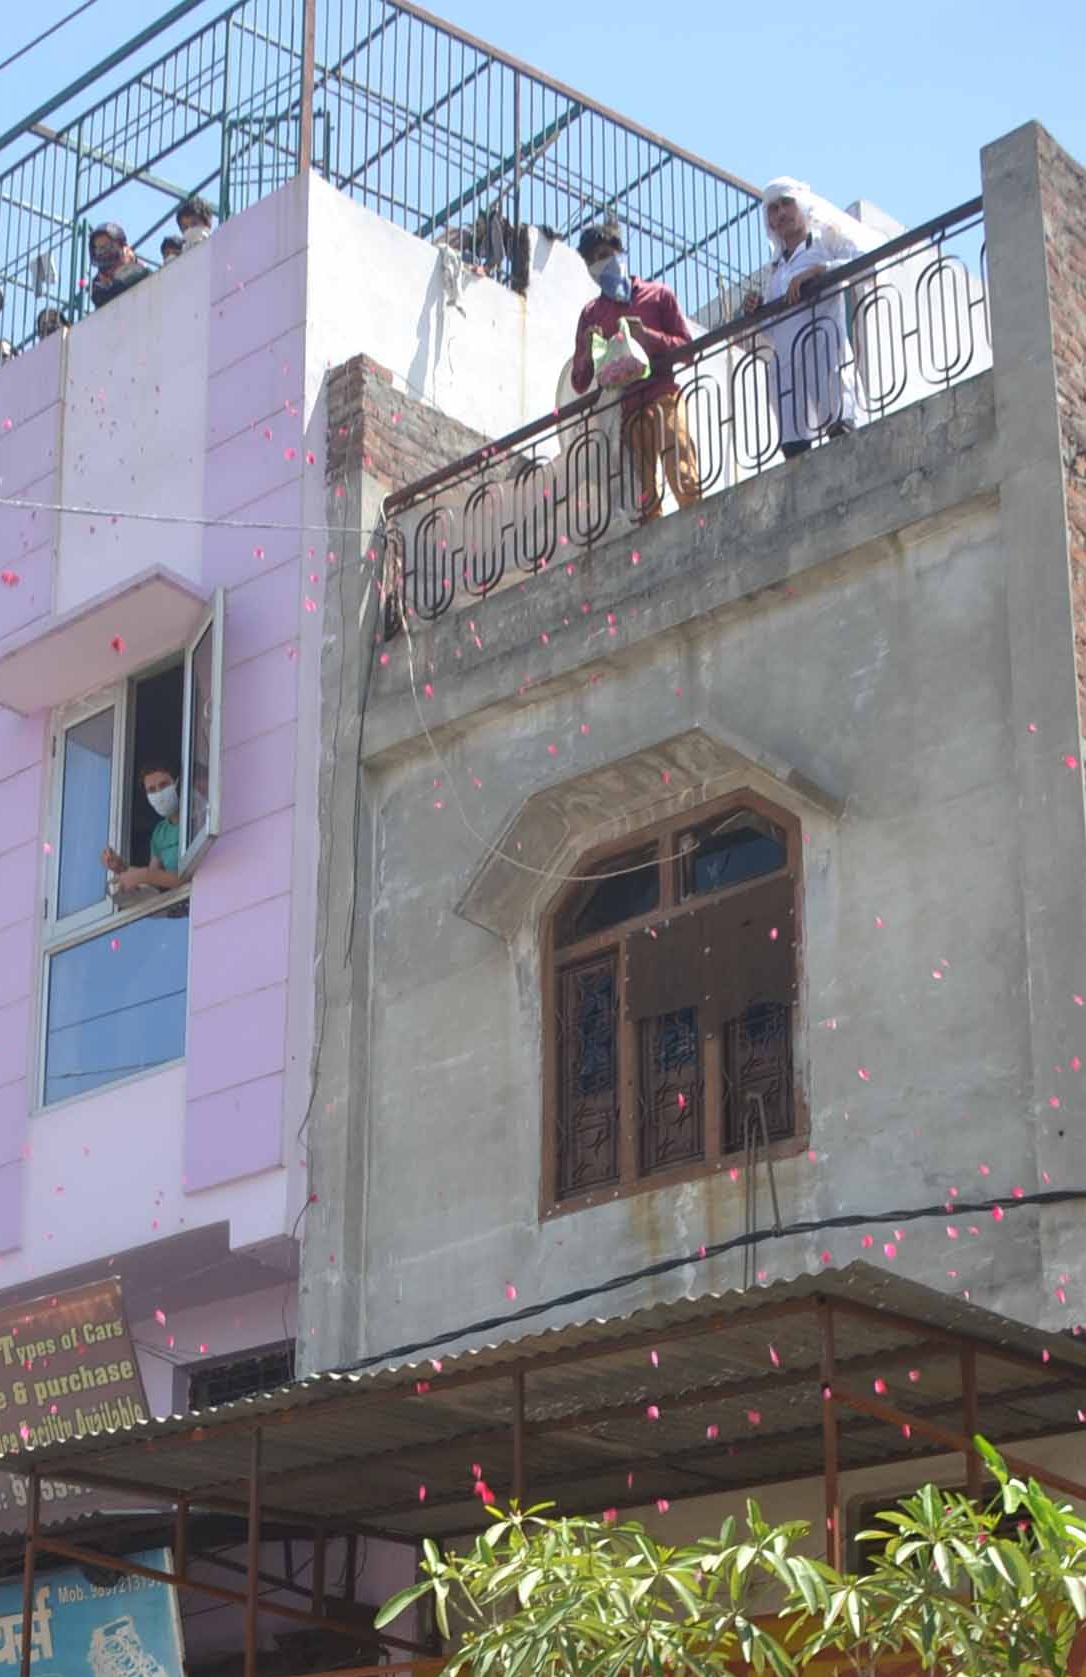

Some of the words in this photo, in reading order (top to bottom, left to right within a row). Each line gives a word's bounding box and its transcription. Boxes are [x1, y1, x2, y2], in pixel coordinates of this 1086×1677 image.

[61, 1328, 79, 1349] of
[82, 1319, 124, 1345] Cars
[12, 1381, 29, 1406] &
[33, 1359, 136, 1406] purchase
